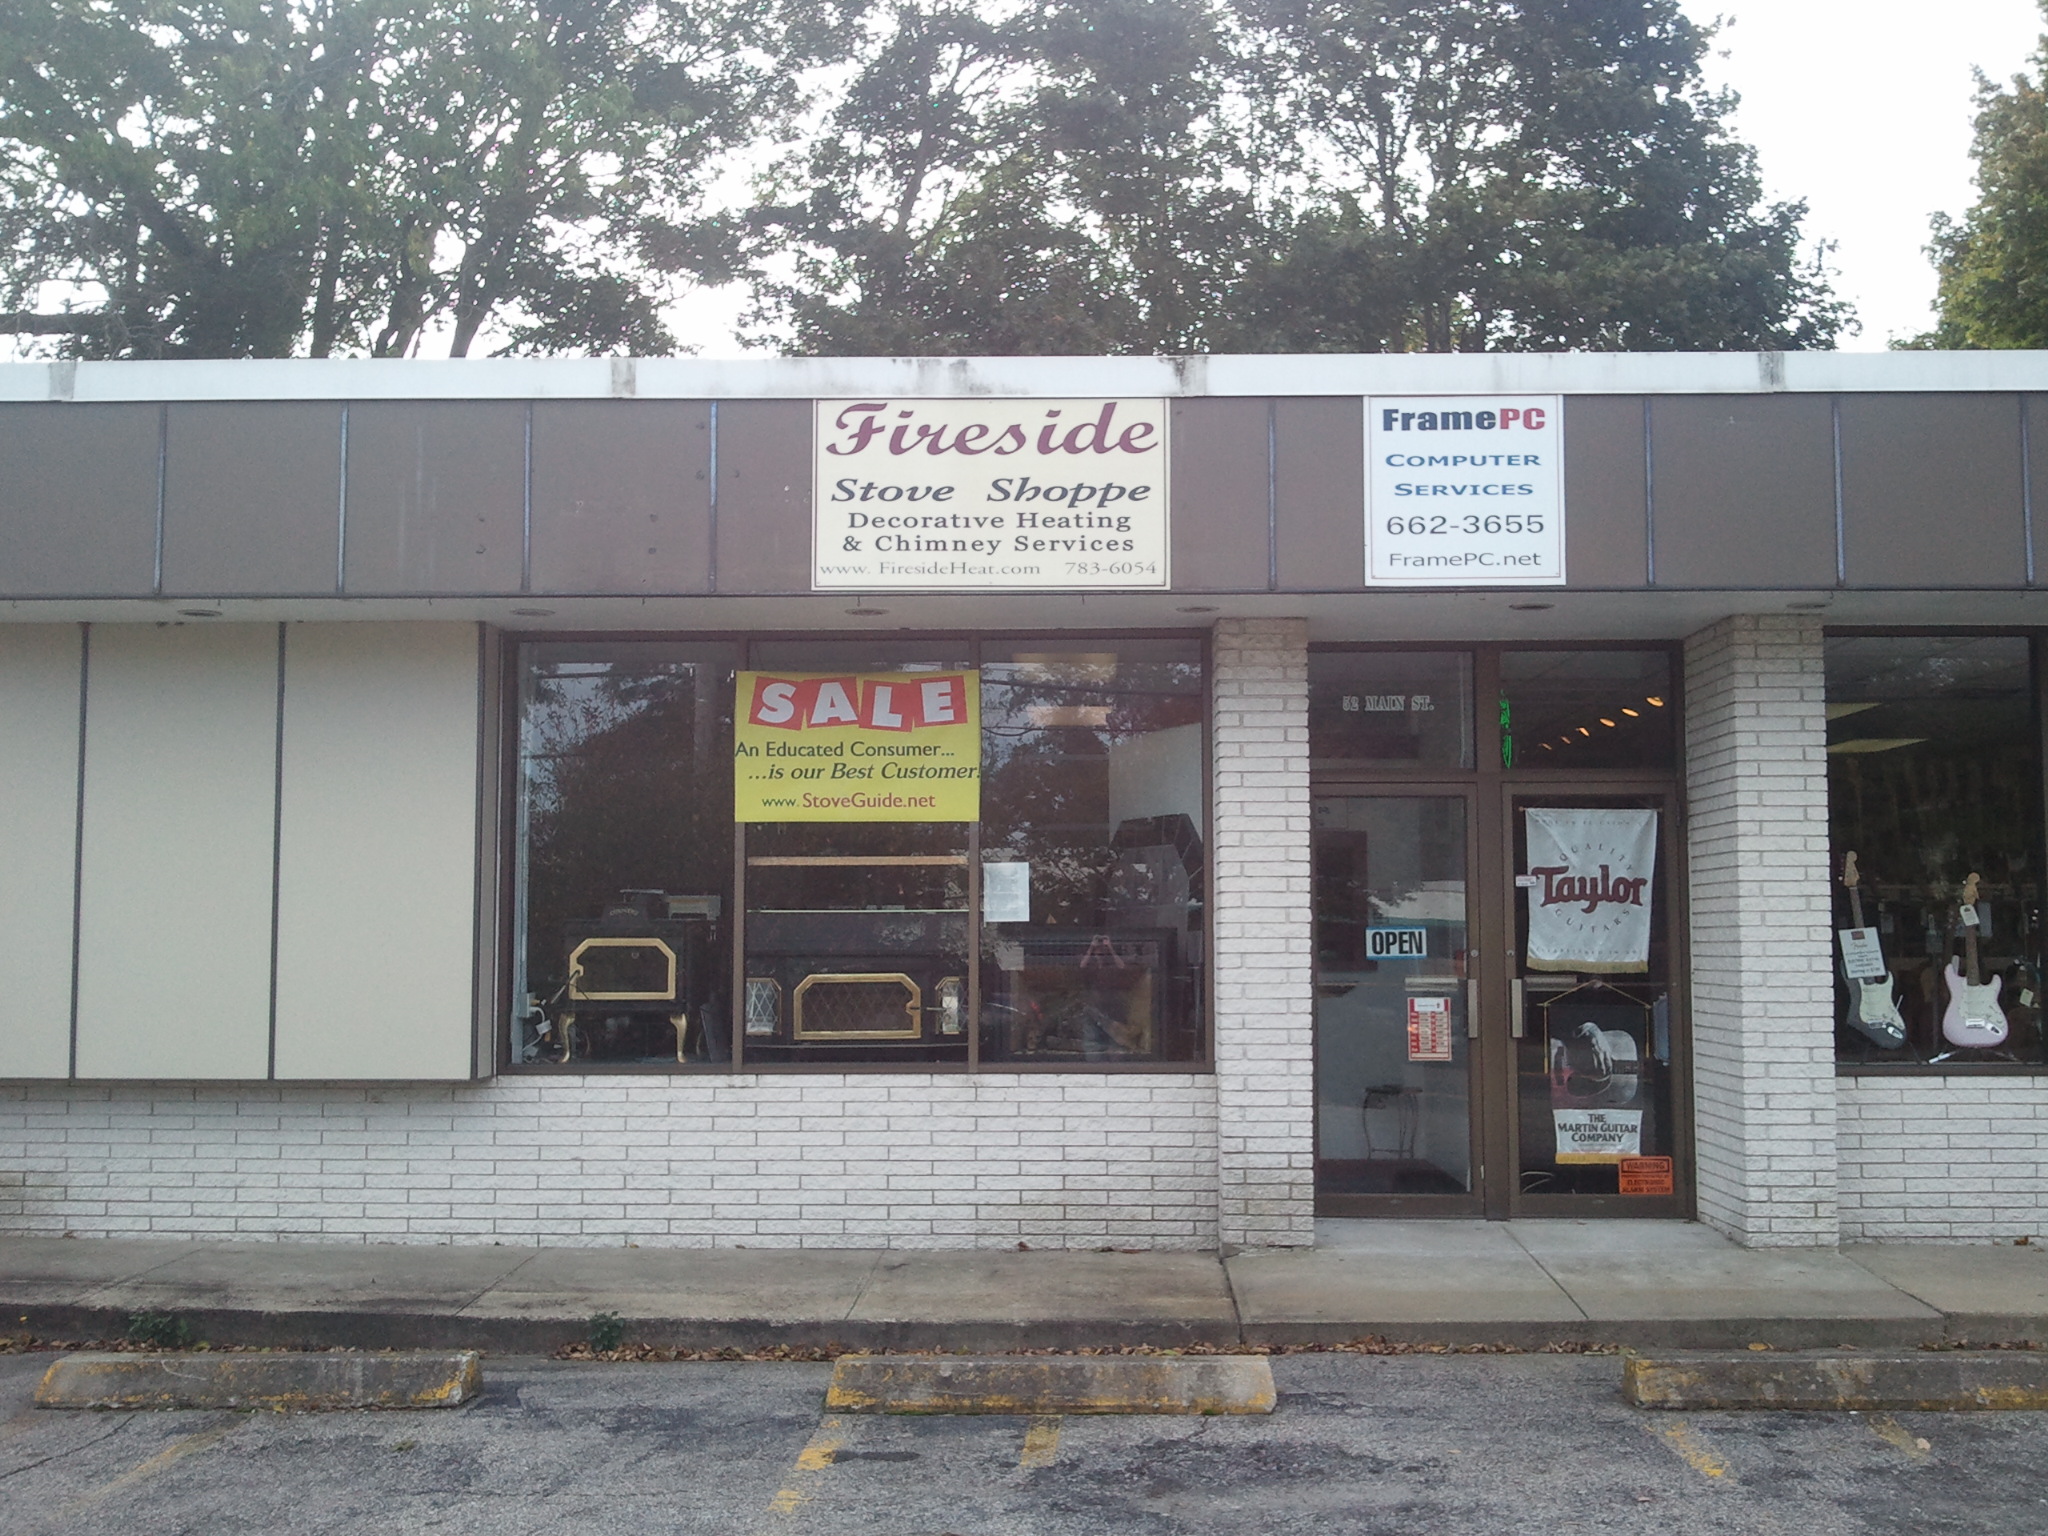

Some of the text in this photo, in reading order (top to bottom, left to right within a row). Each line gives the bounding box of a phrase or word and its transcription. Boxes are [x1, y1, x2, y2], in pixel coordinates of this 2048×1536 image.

[826, 402, 1159, 455] Fireside
[1383, 408, 1546, 431] FramePC
[1386, 454, 1541, 467] COMPUTER
[832, 477, 1151, 508] Stove Shoppe
[1394, 483, 1534, 496] SERVICES
[849, 512, 1132, 532] Decorative Heating
[1387, 515, 1545, 535] 662-3655
[842, 535, 1135, 555] & Chimney Services
[1065, 561, 1157, 575] 783-6054
[1390, 553, 1541, 567] FramePC.net
[757, 681, 955, 728] SALE
[1342, 695, 1435, 711] 52 MAIN ST.
[735, 742, 955, 757] An Educated Consumer...
[791, 767, 825, 779] our
[830, 762, 874, 779] Best
[1560, 843, 1633, 871] QUALITY
[1531, 864, 1648, 914] Taylor
[1555, 908, 1630, 933] GUITARS
[1371, 930, 1423, 954] OPEN
[1558, 1122, 1638, 1134] MARTIN GUITAR
[1587, 1113, 1606, 1123] THE
[1571, 1133, 1625, 1142] COMPANY
